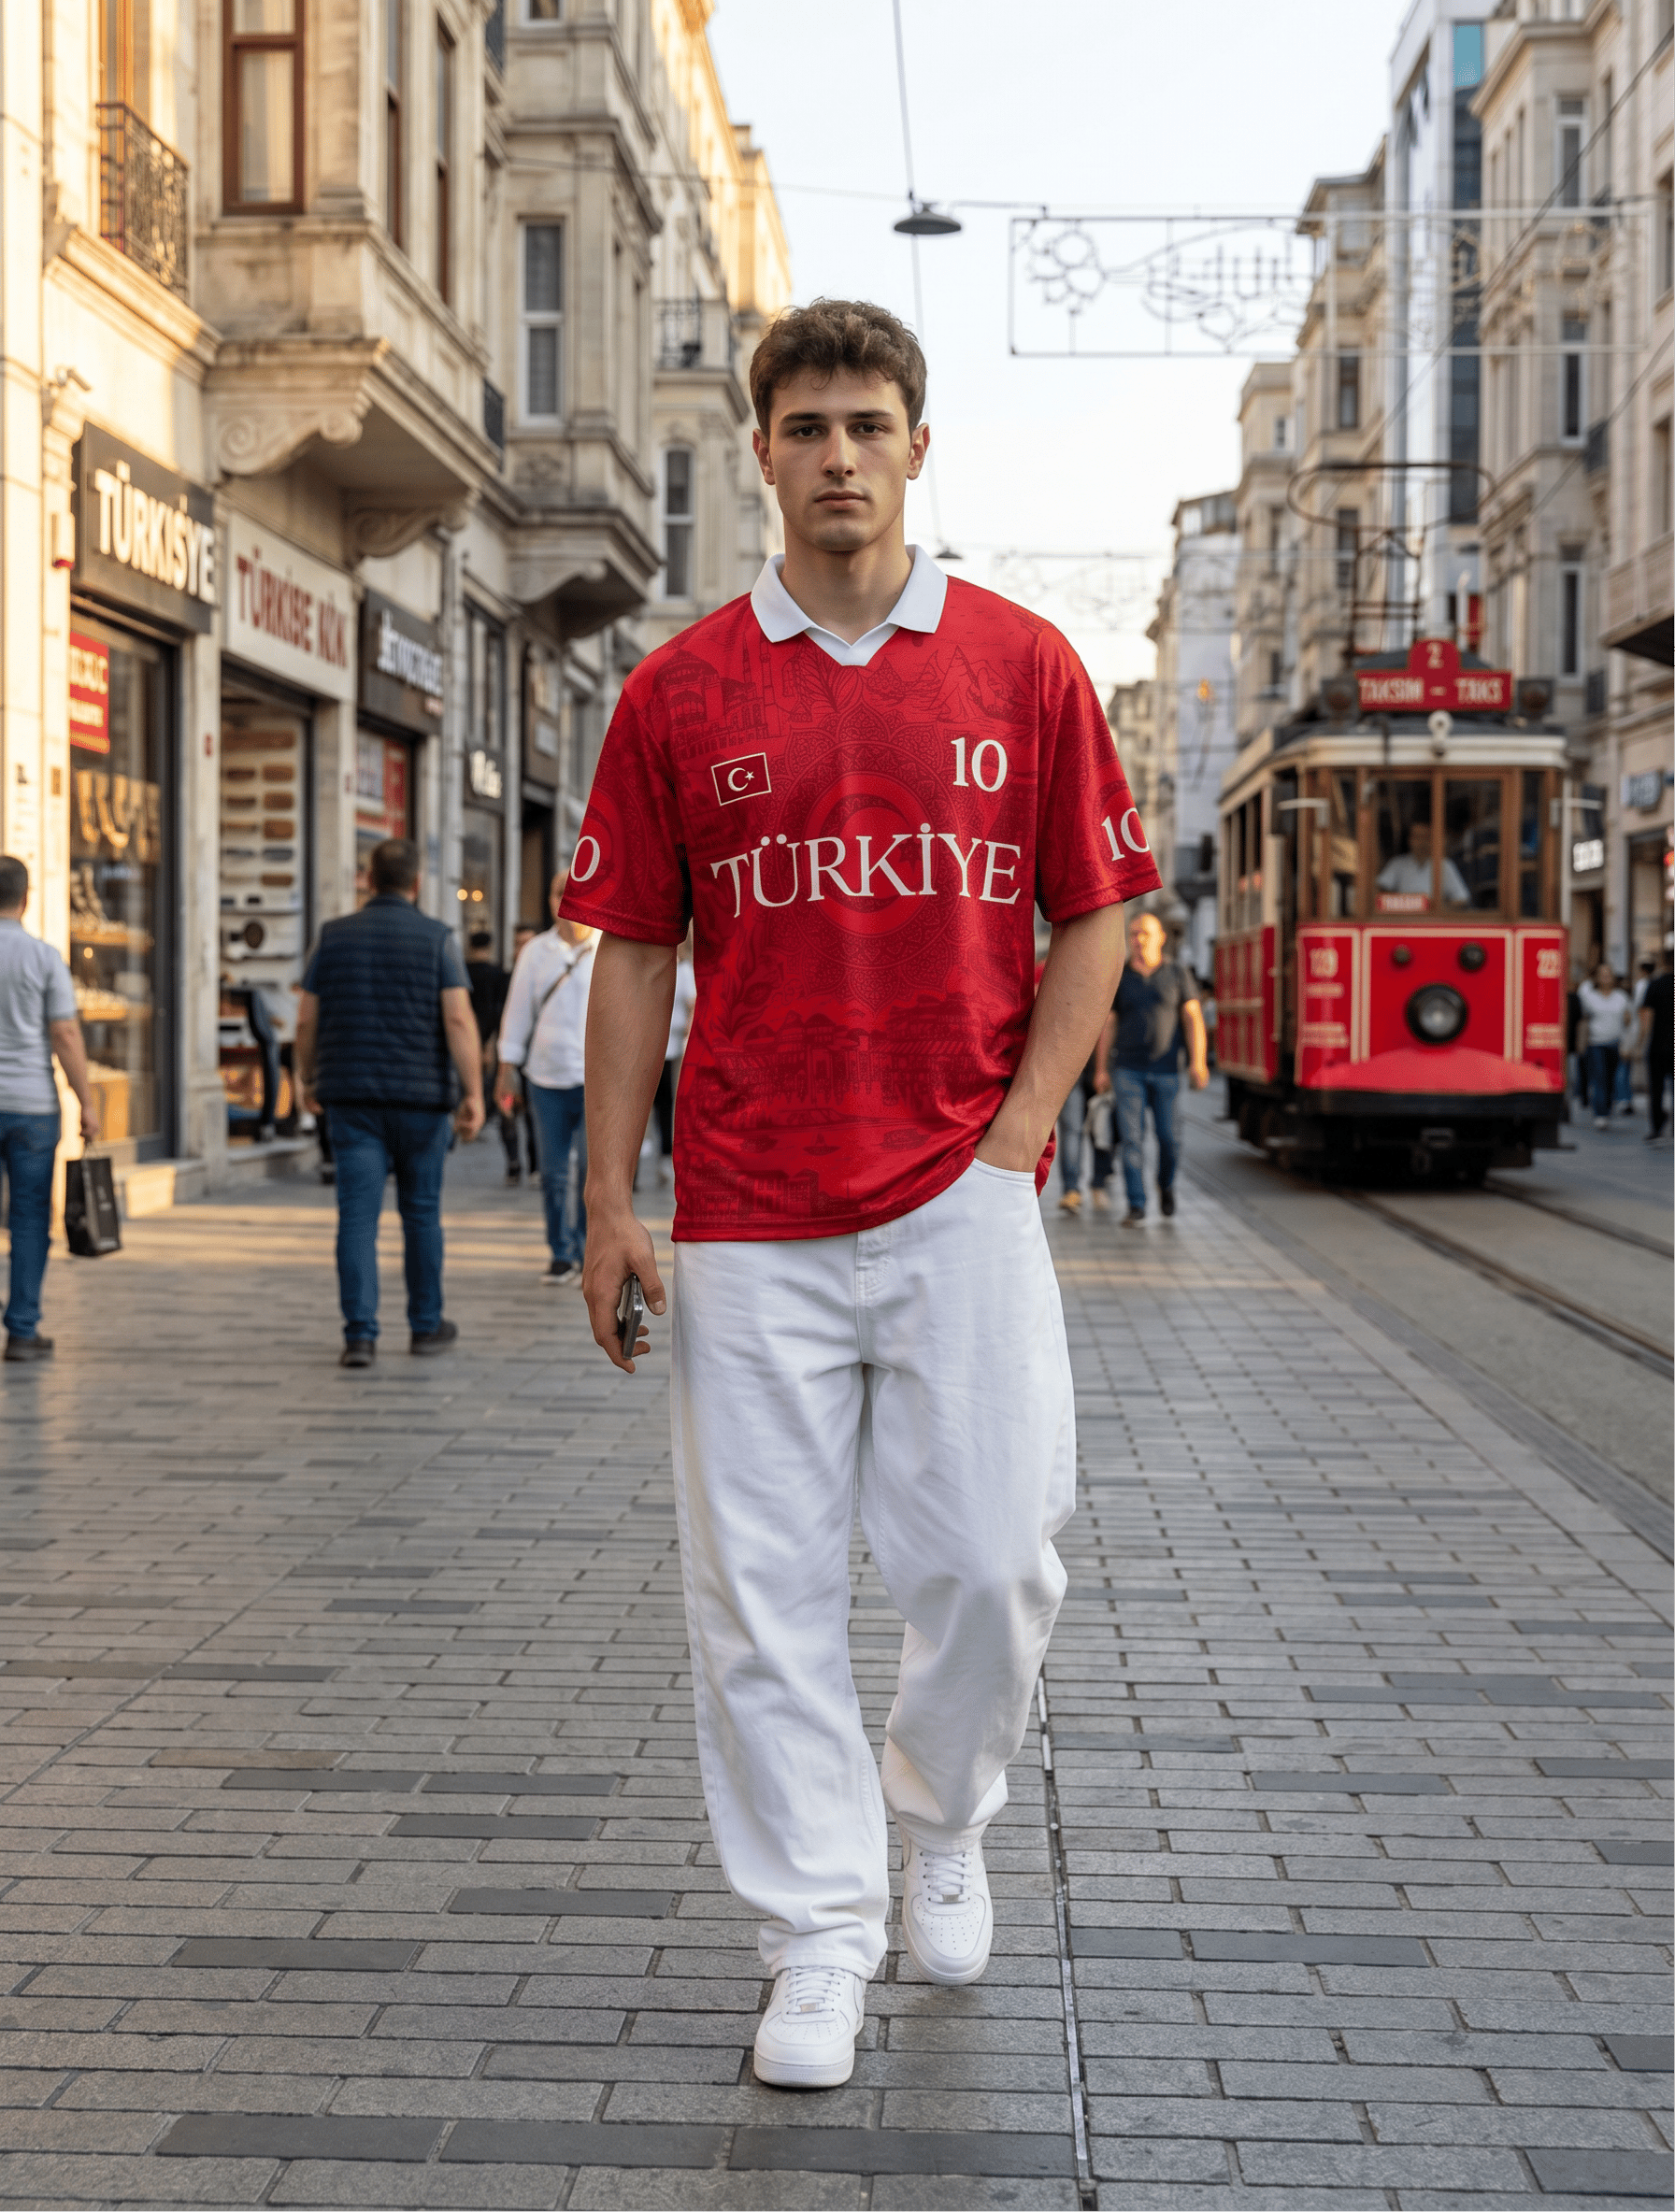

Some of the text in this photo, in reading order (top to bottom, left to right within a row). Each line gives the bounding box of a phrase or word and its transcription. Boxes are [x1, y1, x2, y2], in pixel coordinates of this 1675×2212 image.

[1426, 642, 1444, 670] 2
[951, 736, 1008, 792] 10
[1101, 806, 1151, 862] 10
[709, 822, 1022, 919] TÜRKİYE
